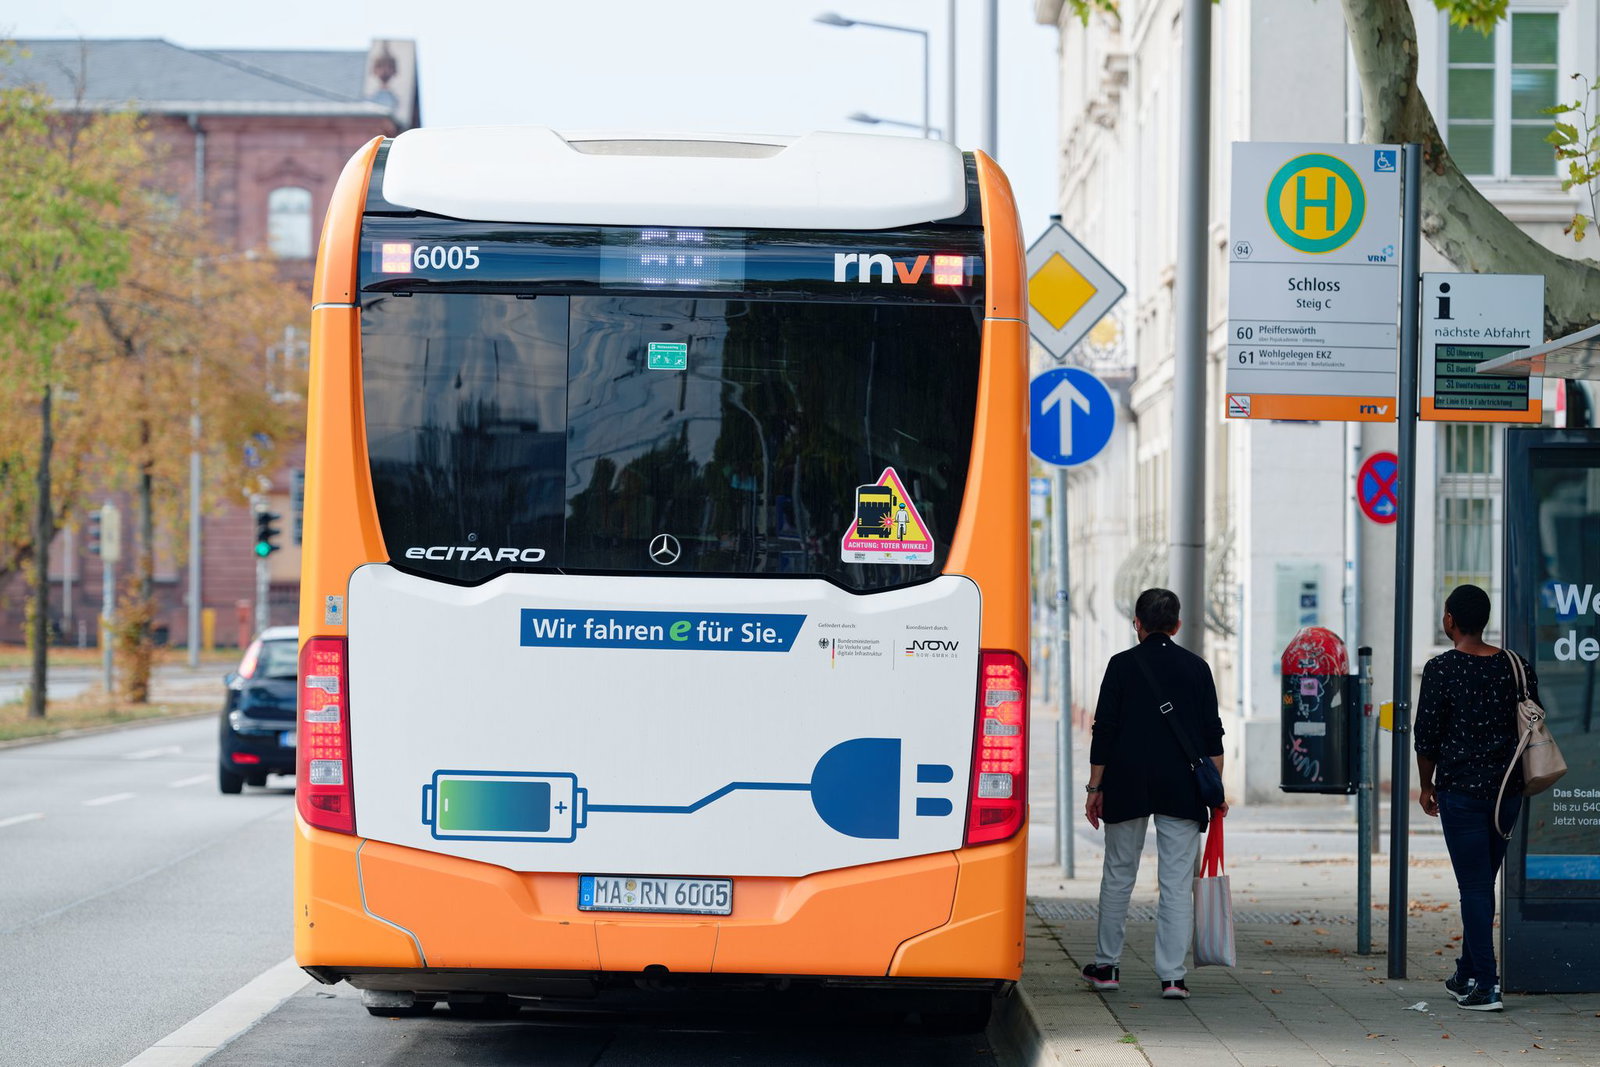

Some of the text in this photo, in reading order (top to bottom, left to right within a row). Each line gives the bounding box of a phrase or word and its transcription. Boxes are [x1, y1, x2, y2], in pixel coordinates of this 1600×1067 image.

[1296, 176, 1336, 230] H
[1237, 246, 1249, 256] 94
[413, 245, 480, 270] 6005
[833, 252, 930, 284] rnv
[1288, 277, 1340, 292] Schloss
[1296, 298, 1332, 311] Steig C
[1237, 327, 1253, 339] 60
[1259, 325, 1316, 335] Pfeifferswörth
[1435, 327, 1531, 339] nächste Abfahrt
[1239, 351, 1254, 364] 61
[1259, 350, 1332, 361] Wohlgelegen EKZ
[1360, 404, 1388, 415] rnv
[405, 546, 545, 562] eCITARO
[533, 618, 783, 643] Wir fahren e für Sie.
[905, 640, 959, 651] NOW
[1553, 788, 1572, 798] Das
[1553, 802, 1567, 812] bis
[1569, 804, 1580, 812] zu
[1553, 816, 1576, 826] Jetzt
[595, 880, 622, 904] MA
[640, 881, 667, 905] RN
[675, 882, 728, 907] 6005
